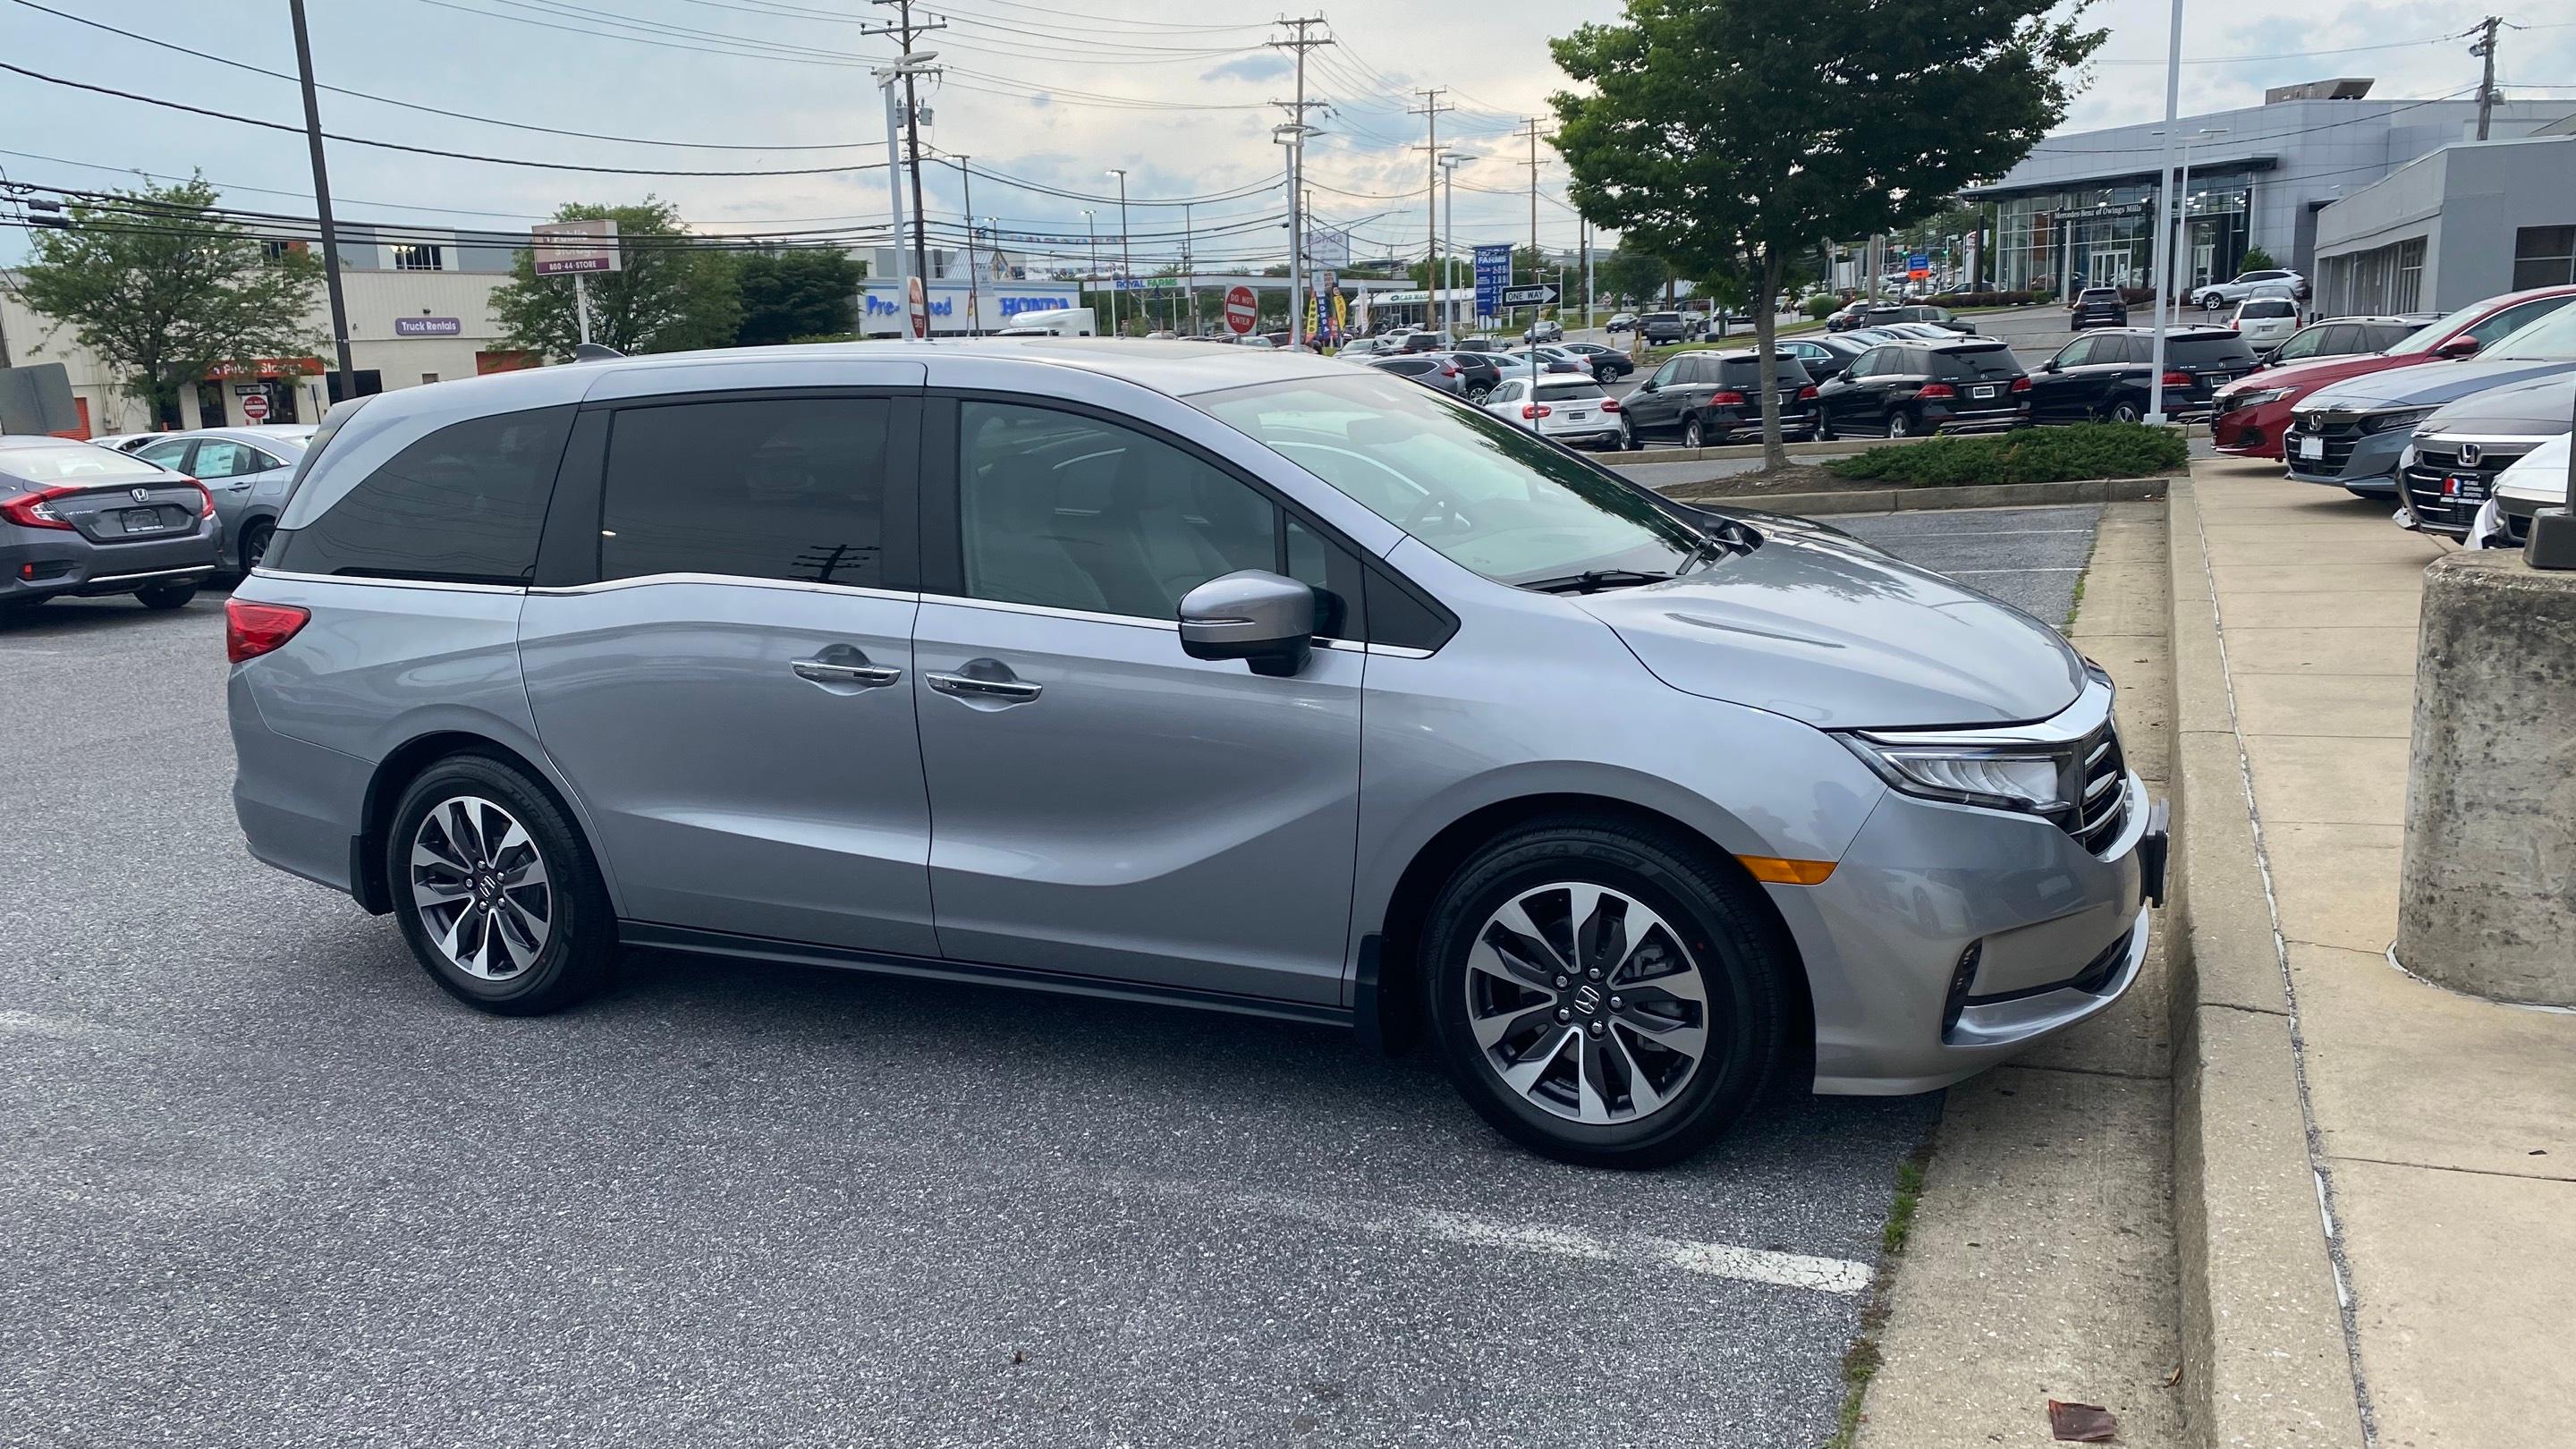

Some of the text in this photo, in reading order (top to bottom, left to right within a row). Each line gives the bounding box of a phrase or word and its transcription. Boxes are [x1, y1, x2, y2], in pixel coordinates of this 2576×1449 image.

[2103, 207, 2125, 216] Owings
[2126, 204, 2141, 213] Mills
[1116, 278, 1178, 289] ROYAL FARMS
[1230, 293, 1253, 305] DO NOT
[1508, 292, 1522, 301] ONE
[1527, 291, 1544, 300] WAY
[999, 297, 1070, 317] HONDA
[1232, 316, 1250, 326] ENTER
[1318, 299, 1330, 333] HONDA
[402, 321, 456, 331] Truck Rentals
